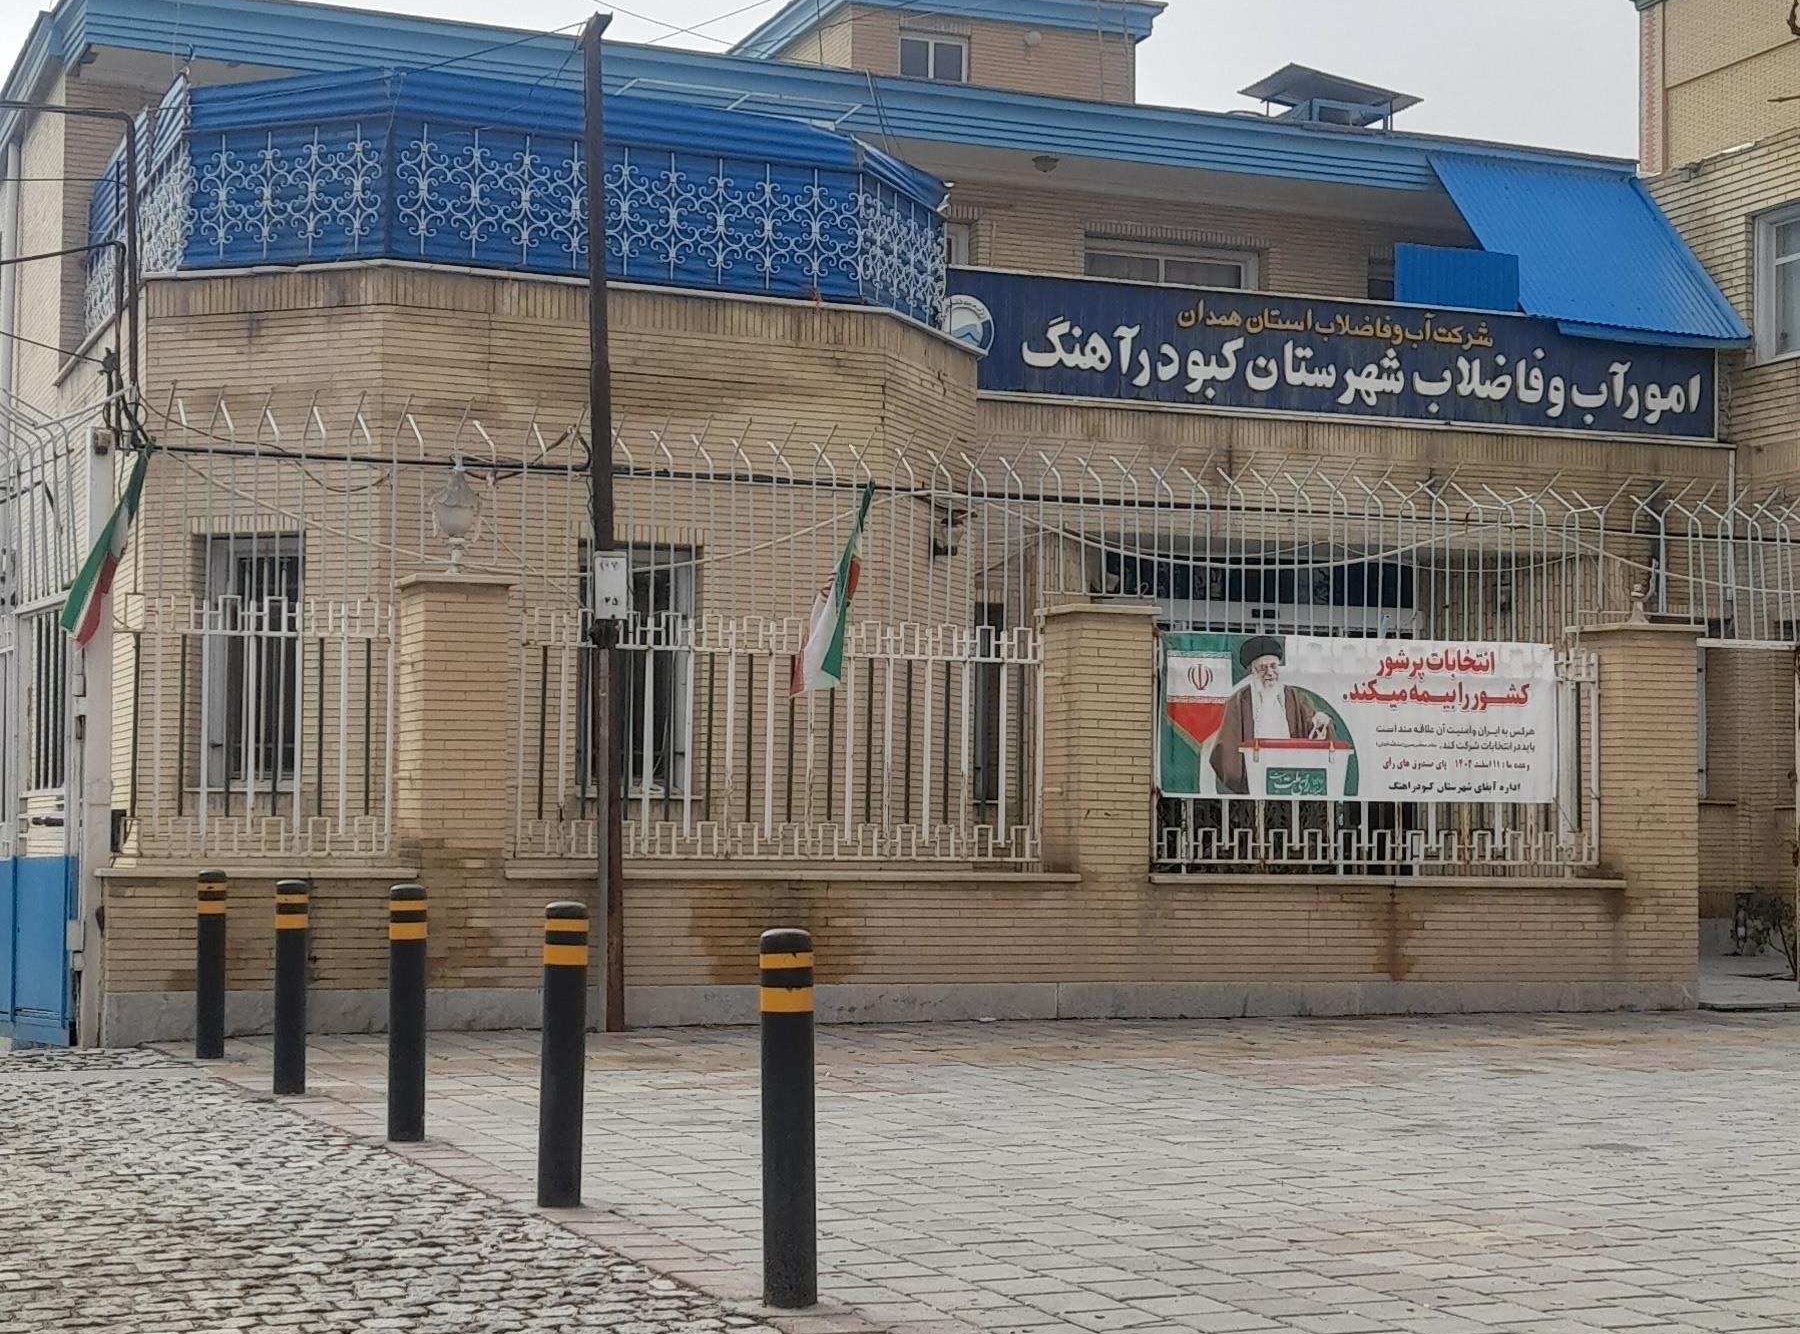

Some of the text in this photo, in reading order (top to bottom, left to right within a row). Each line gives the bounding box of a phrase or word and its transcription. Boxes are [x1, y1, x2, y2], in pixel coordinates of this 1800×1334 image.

[1177, 298, 1241, 328] همدان
[1245, 307, 1312, 333] استان
[1315, 312, 1392, 343] فاضلاب
[1405, 312, 1434, 349] آب
[1432, 320, 1494, 351] شرکت
[1245, 338, 1405, 407] شهرستان
[1411, 346, 1546, 414] فاضلاب
[1570, 361, 1631, 425] آب
[1621, 372, 1702, 425] امور
[1426, 649, 1496, 680] انتخابات
[1408, 684, 1457, 710] بیمه
[1457, 681, 1470, 710] را
[1473, 682, 1530, 711] کشور
